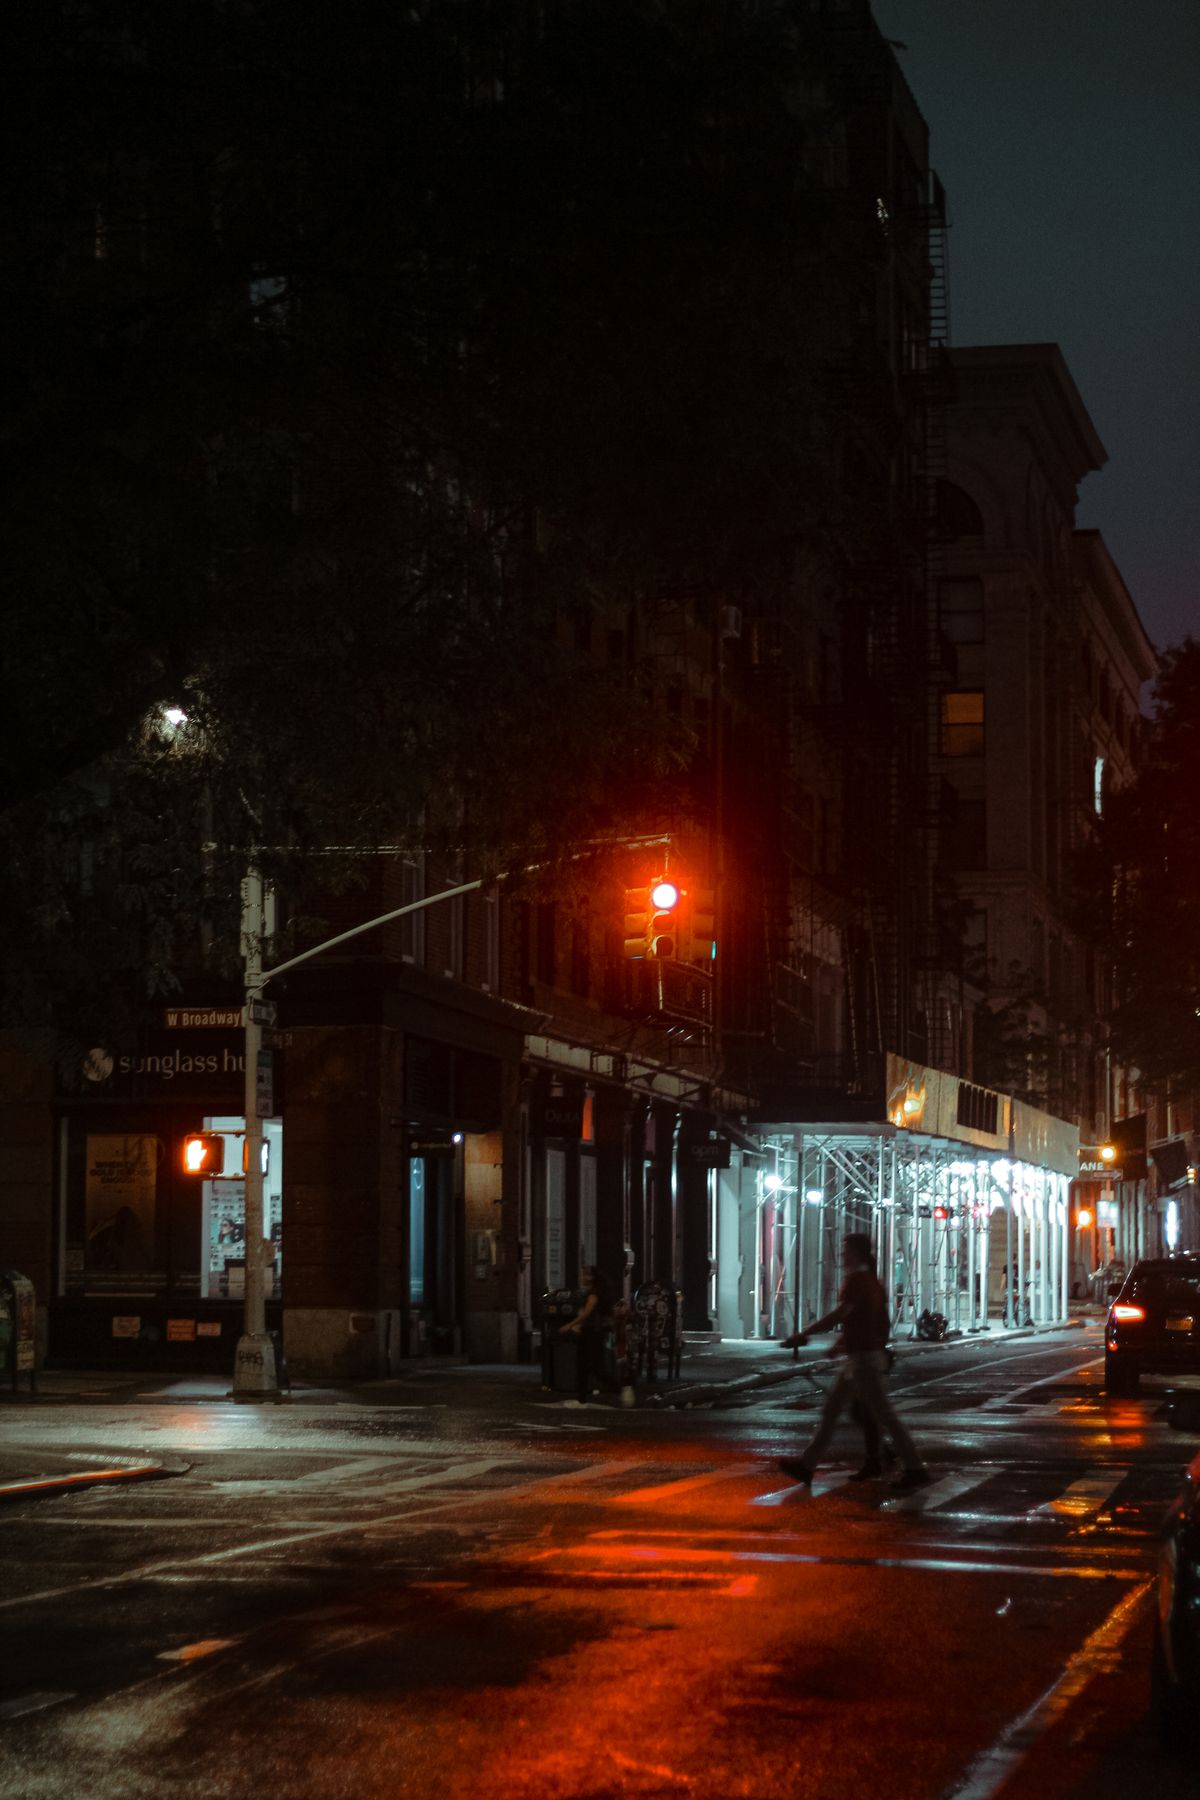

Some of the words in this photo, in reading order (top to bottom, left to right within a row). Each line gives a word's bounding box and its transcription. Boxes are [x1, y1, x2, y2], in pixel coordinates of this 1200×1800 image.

[167, 1012, 178, 1027] W
[182, 1010, 240, 1028] Broadway
[120, 1048, 218, 1080] sunglass
[223, 1048, 246, 1073] hu
